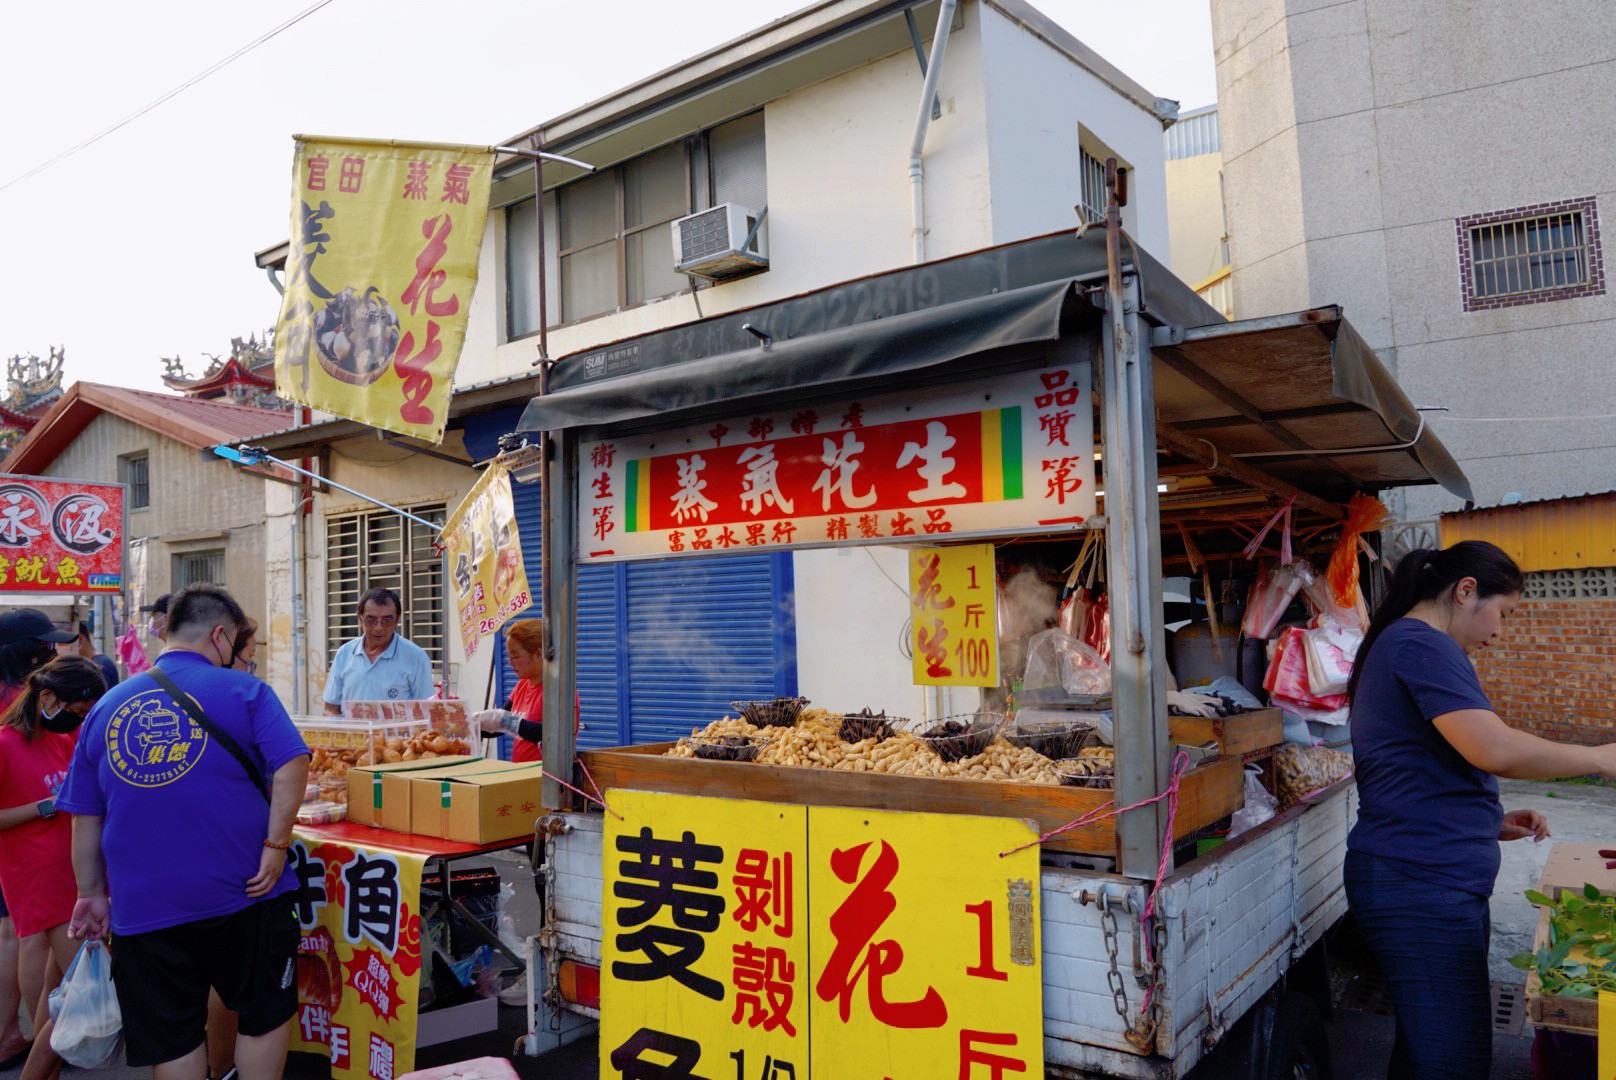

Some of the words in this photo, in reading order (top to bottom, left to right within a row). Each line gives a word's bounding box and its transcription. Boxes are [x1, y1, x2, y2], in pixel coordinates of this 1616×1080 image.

[307, 154, 365, 194] 官田
[402, 161, 475, 205] 蒸氣
[394, 212, 459, 425] 花生
[589, 441, 617, 557] 衛生第一
[669, 420, 967, 525] 蒸氣花生
[1034, 369, 1086, 527] 品質第一
[826, 508, 953, 541] 精製出品
[914, 553, 955, 678] 花生
[816, 839, 948, 1080] 花
